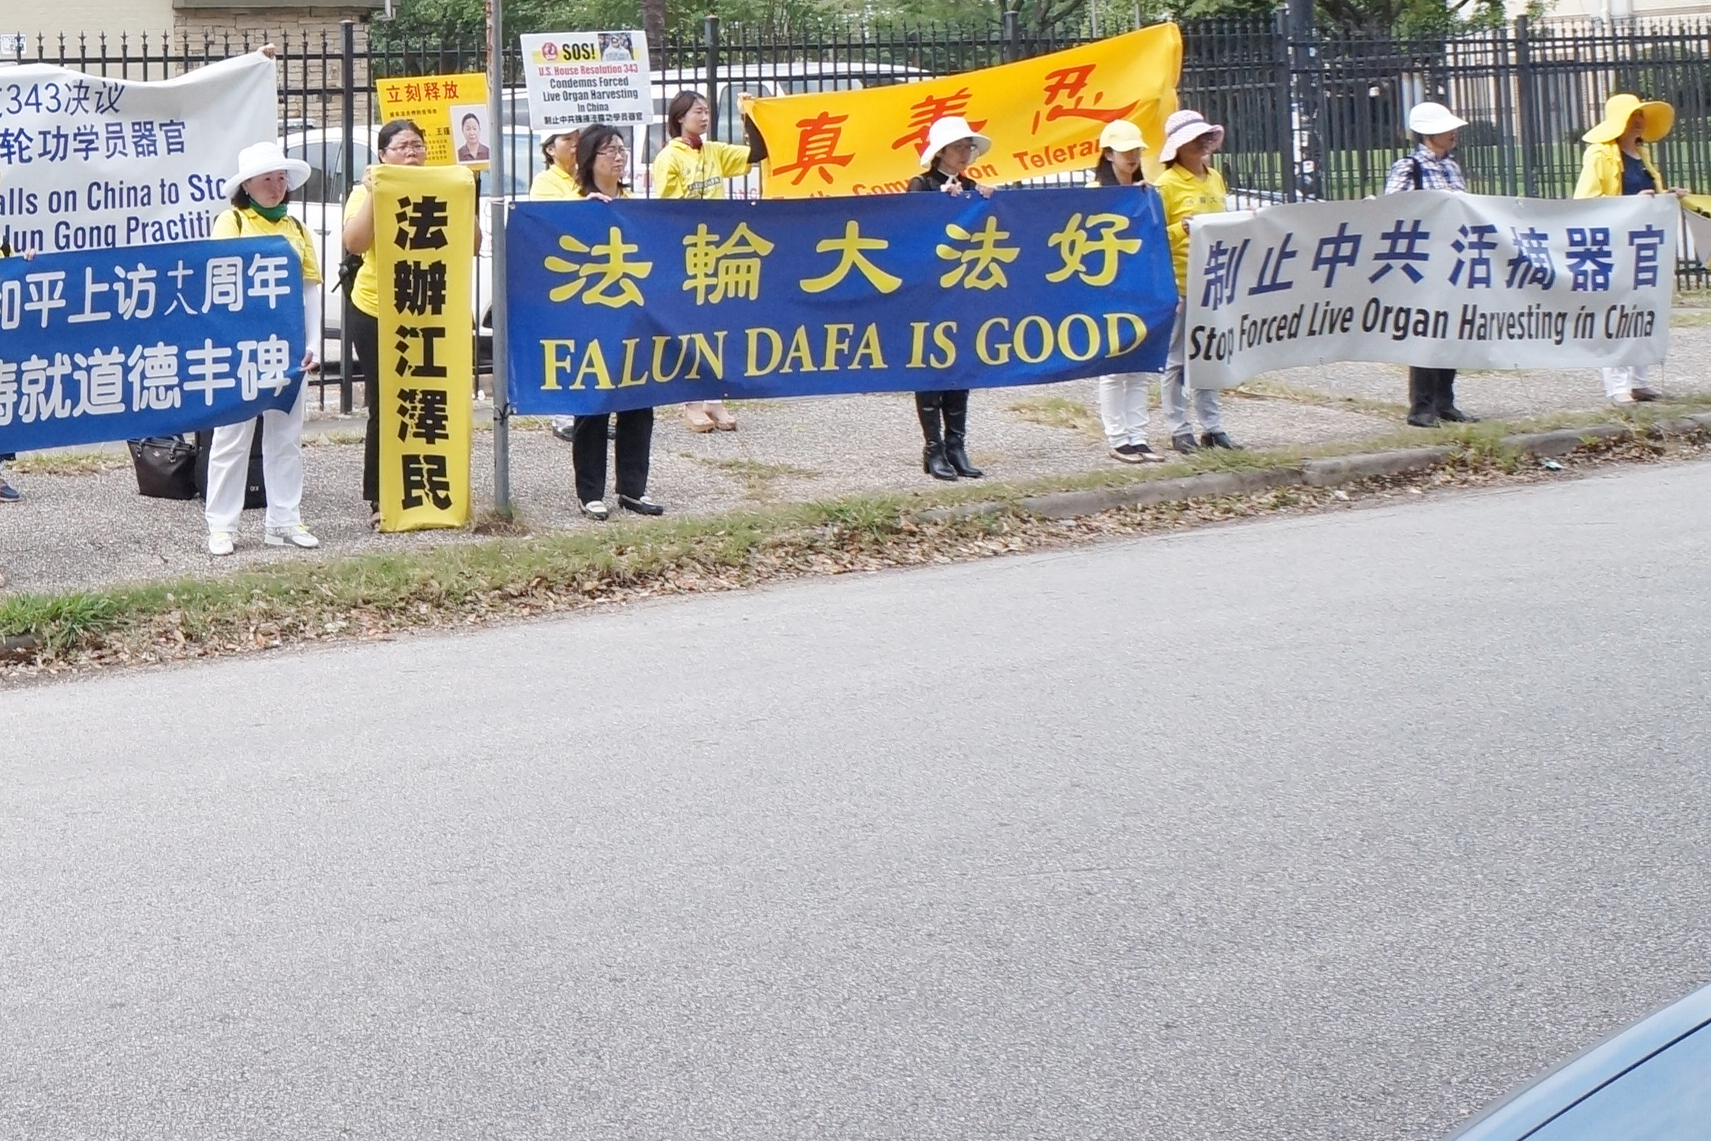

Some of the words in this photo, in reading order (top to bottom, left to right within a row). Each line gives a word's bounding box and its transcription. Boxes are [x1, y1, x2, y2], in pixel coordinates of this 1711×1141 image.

[539, 66, 553, 77] U.S.
[554, 66, 579, 76] House
[580, 64, 622, 75] Resolution
[624, 63, 639, 73] 343
[562, 43, 596, 61] SOS!
[385, 80, 460, 104] 立刻释放
[543, 91, 561, 102] Live
[562, 90, 589, 102] Organ
[591, 89, 639, 100] Harvesting
[549, 78, 597, 89] Condemns
[599, 76, 629, 87] Forced
[586, 102, 609, 112] China
[48, 189, 78, 213] on
[87, 179, 152, 211] China
[159, 178, 180, 206] to
[187, 173, 227, 202] Sto
[54, 220, 117, 250] Gong
[126, 210, 219, 245] Practiti
[544, 211, 1142, 309] 法輪大法好
[1200, 218, 1665, 311] 制止中共活摘器官
[1188, 324, 1235, 364] Stop
[1238, 303, 1305, 352] Forced
[1306, 300, 1354, 337] Live
[1361, 297, 1450, 341] Organ
[1457, 303, 1568, 346] Harvesting
[1572, 304, 1595, 340] in
[1604, 304, 1656, 339] China
[393, 195, 453, 511] 法辦江澤民
[539, 330, 729, 392] FALUN
[743, 321, 889, 378] DAFA
[906, 321, 958, 370] IS
[975, 312, 1148, 366] GOOD
